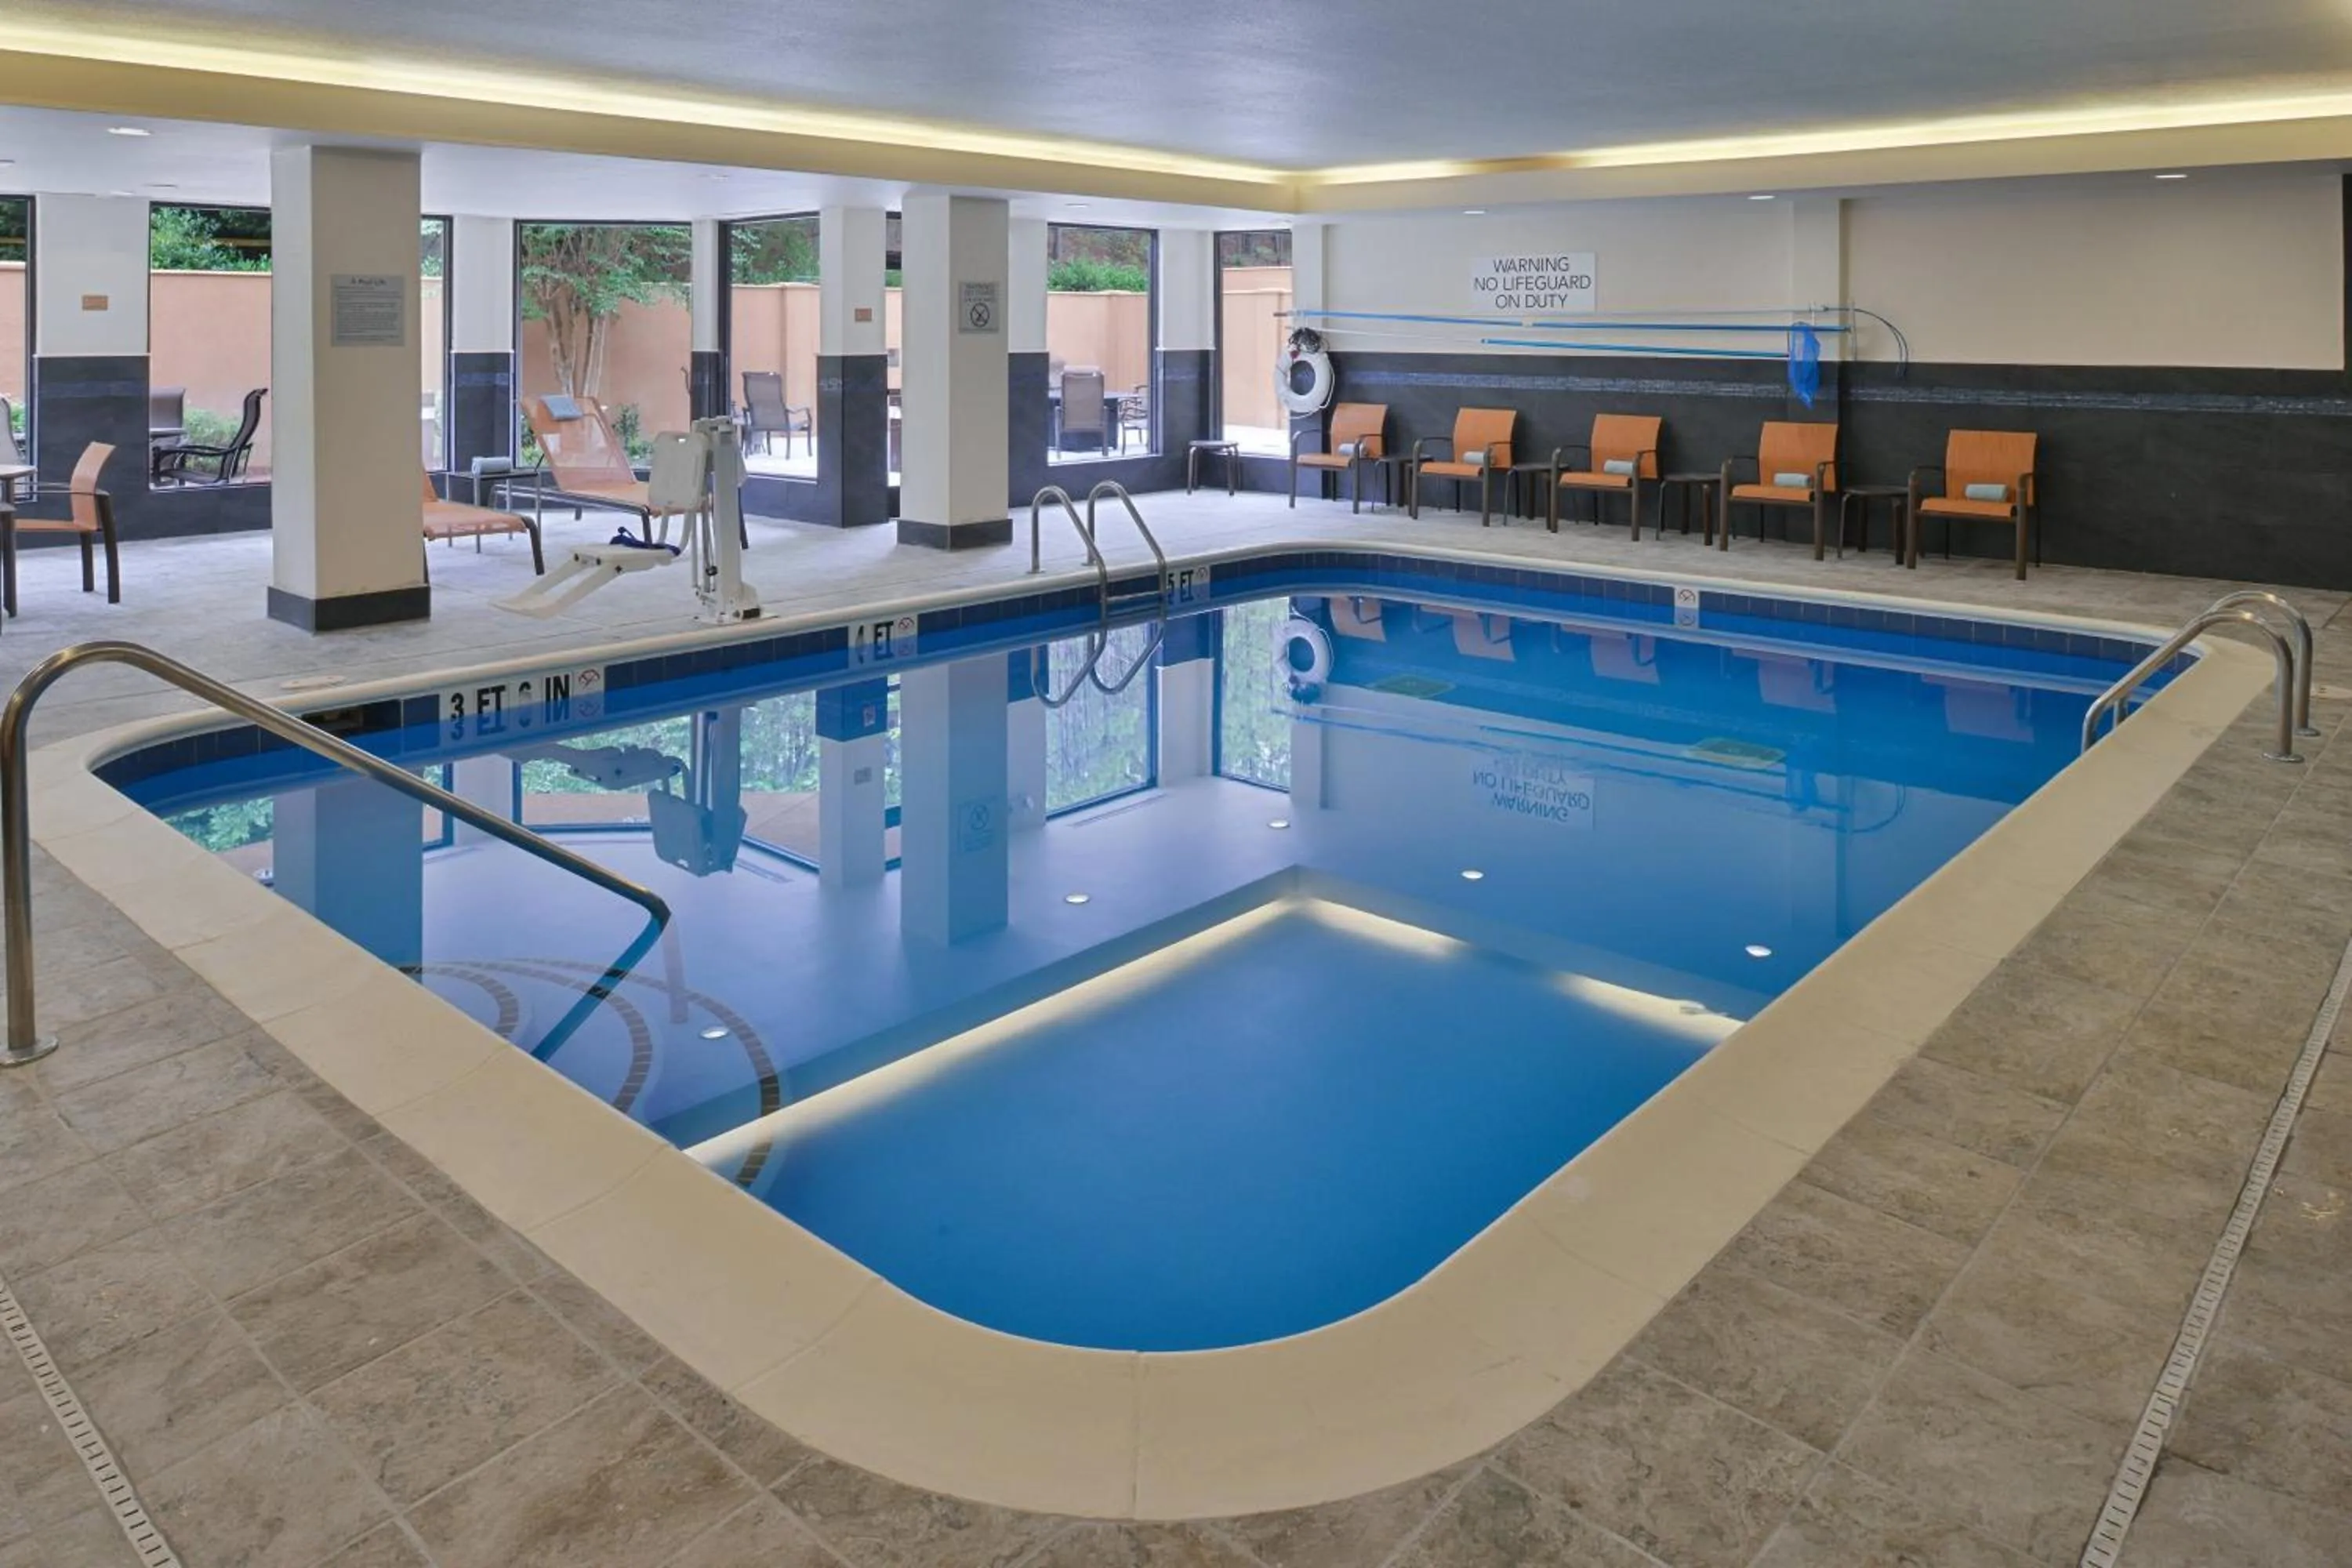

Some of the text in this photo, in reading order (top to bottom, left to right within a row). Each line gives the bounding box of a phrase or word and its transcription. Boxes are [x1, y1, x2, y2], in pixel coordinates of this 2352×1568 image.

[1493, 256, 1570, 274] WARNING
[1474, 274, 1592, 291] NO LIFEGUARD
[1495, 293, 1567, 309] ON DUTY
[451, 693, 464, 719] 3
[477, 684, 506, 715] FT
[546, 674, 570, 702] IN
